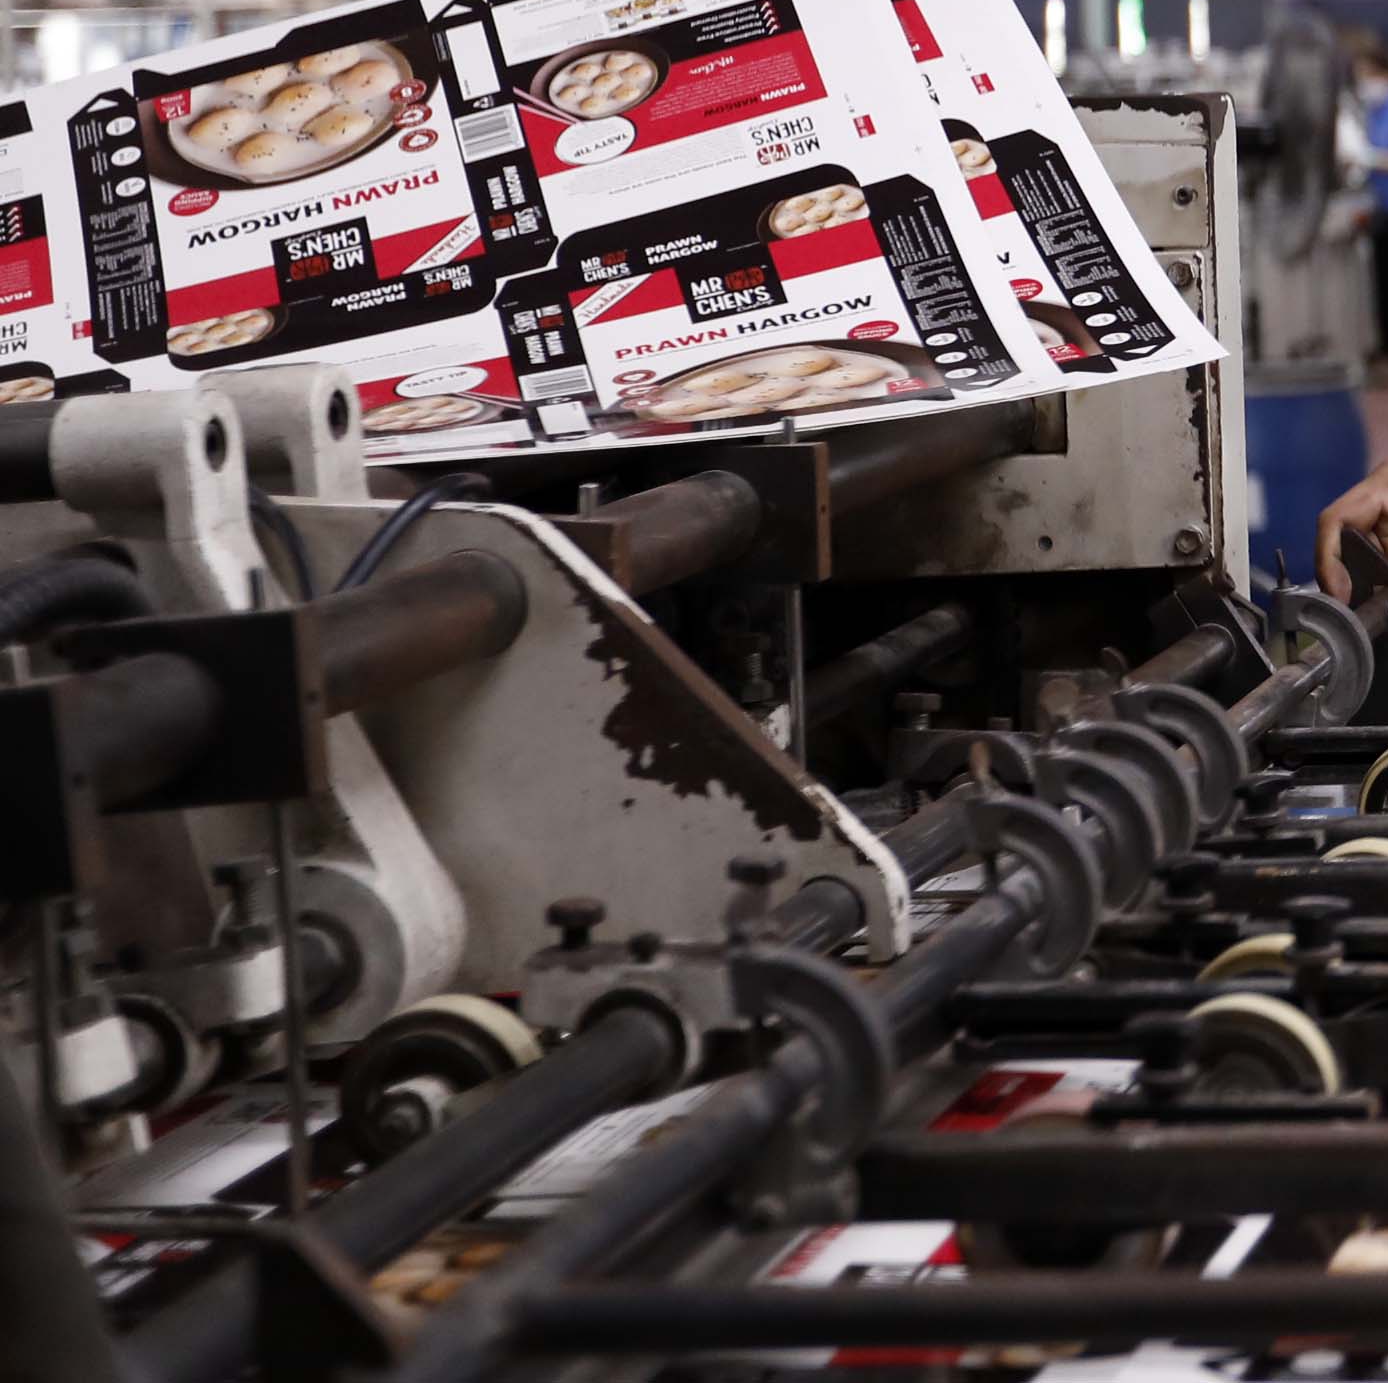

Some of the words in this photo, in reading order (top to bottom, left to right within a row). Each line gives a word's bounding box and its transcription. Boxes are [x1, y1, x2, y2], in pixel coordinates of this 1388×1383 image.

[760, 82, 806, 103] PRAWN
[594, 132, 627, 150] TASTY
[751, 116, 815, 146] CHEN'S
[574, 146, 592, 158] TIP
[794, 137, 821, 156] MR
[332, 169, 440, 211] PRAWN
[187, 201, 323, 249] HARGOW
[287, 226, 361, 261] CHEN'S
[644, 234, 703, 257] PRAWN
[647, 239, 719, 266] HARGOW
[332, 248, 365, 271] MR
[580, 256, 602, 272] MR
[423, 264, 470, 285] CHEN'S
[452, 276, 473, 291] MR
[583, 262, 631, 283] CHEN'S
[331, 281, 405, 308] HARGOW
[690, 276, 724, 297] MR
[347, 290, 407, 313] PRAWN
[695, 285, 772, 316] CHEN'S
[614, 326, 729, 361] PRAWN
[736, 294, 874, 335] HARGOW
